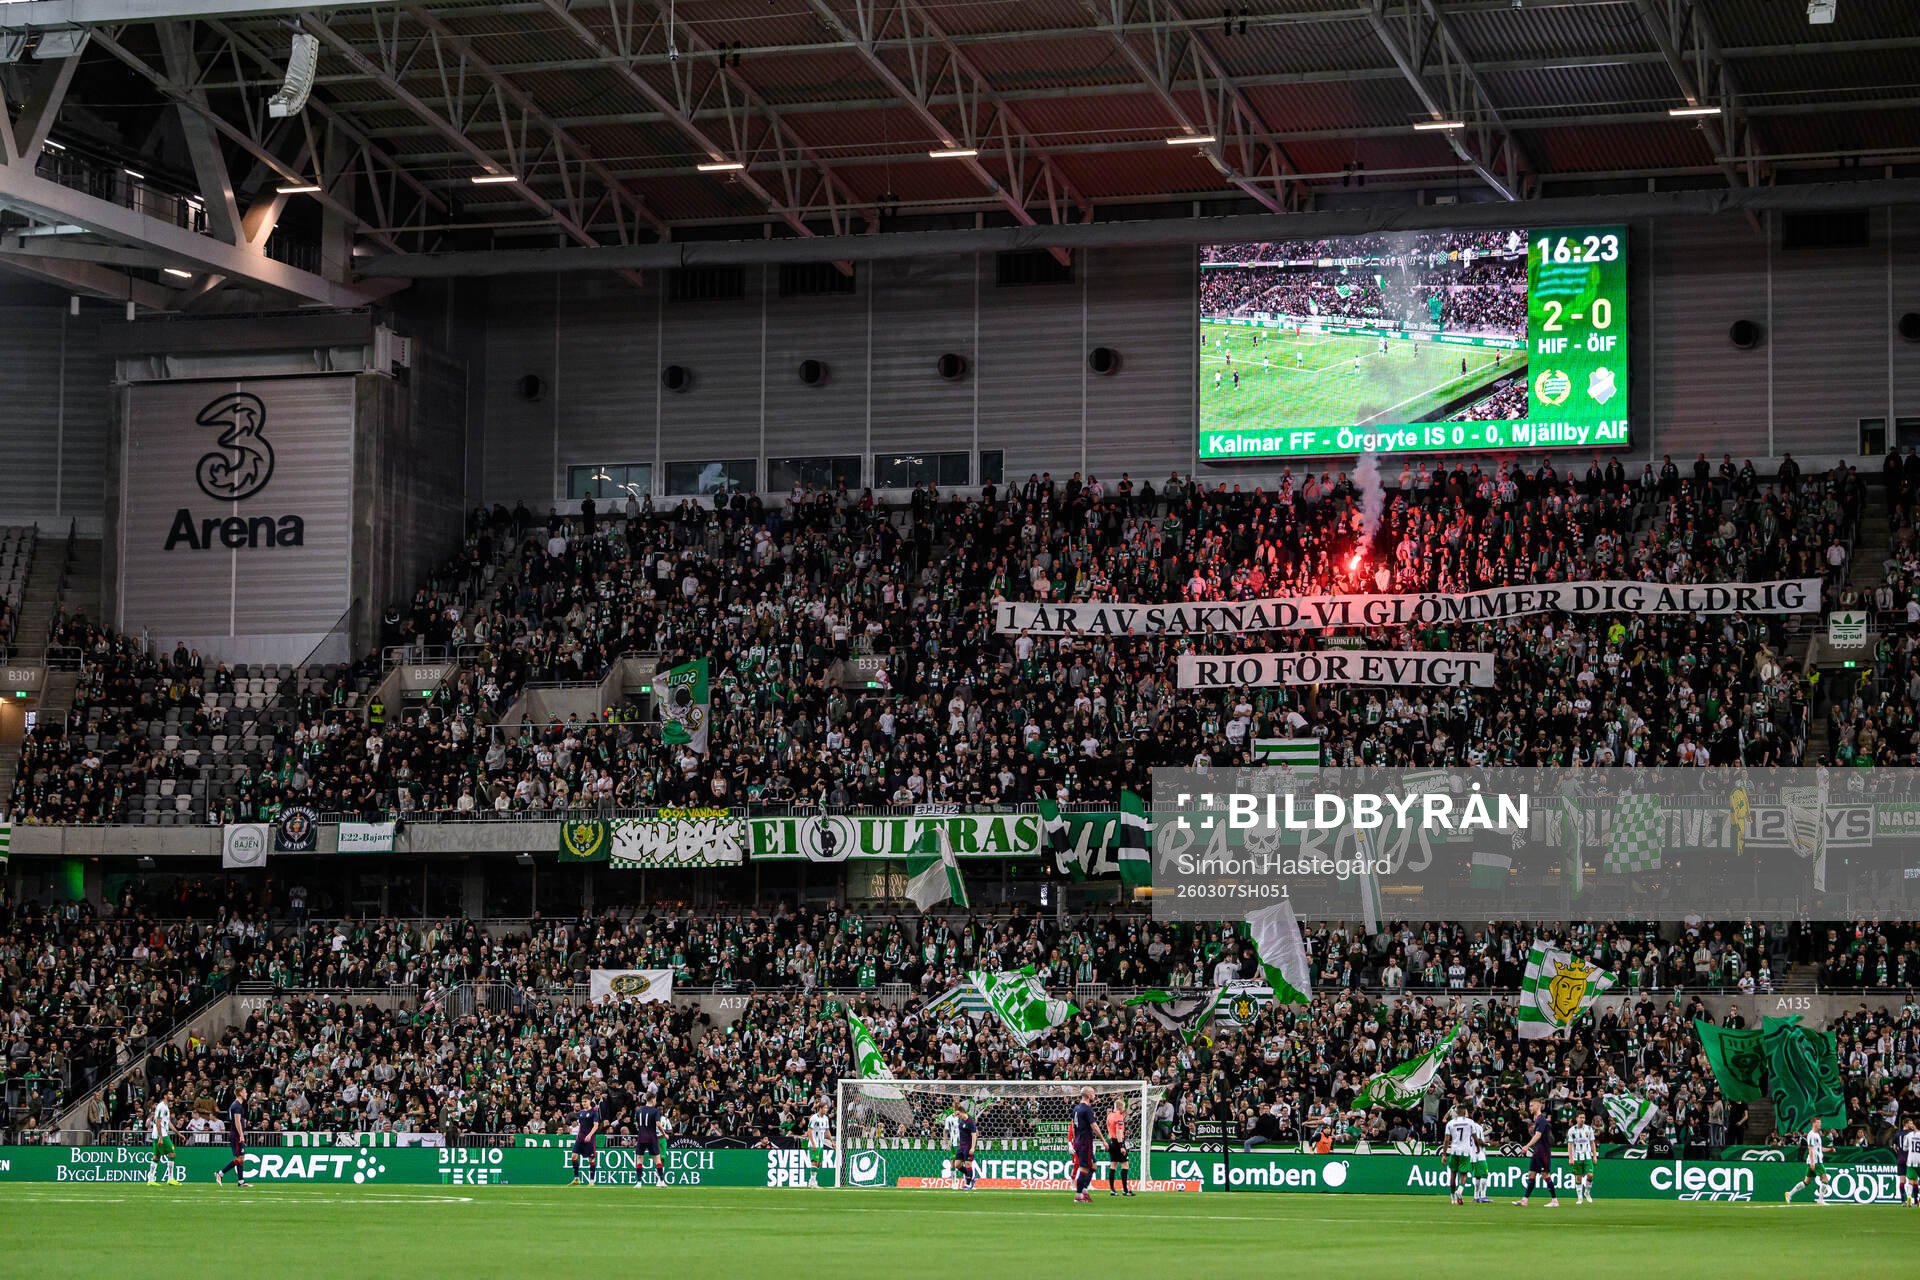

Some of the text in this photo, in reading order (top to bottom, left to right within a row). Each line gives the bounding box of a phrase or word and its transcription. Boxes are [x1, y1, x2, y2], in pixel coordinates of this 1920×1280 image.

[1536, 234, 1619, 265] 16:23
[1543, 300, 1563, 332] 2
[1592, 299, 1612, 329] 0
[1538, 337, 1568, 354] HIF
[1587, 333, 1616, 353] ÖIF
[1209, 432, 1283, 455] Kalmar
[1289, 431, 1315, 451] FF
[1337, 427, 1418, 453] Örgryte
[1423, 426, 1446, 446] IS
[1452, 426, 1464, 444] 0
[1485, 425, 1503, 446] 0,
[1512, 421, 1589, 445] Mjällby
[164, 509, 304, 550] Arena
[1031, 603, 1079, 634] ÅR
[1090, 607, 1138, 634] AV
[1363, 589, 1561, 625] GLÖMMER
[1572, 584, 1646, 612] DIG
[1653, 582, 1807, 612] ALDRIG
[8, 671, 35, 681] B301
[414, 669, 441, 681] B338
[1195, 653, 1481, 686] RIO FÖR EVIGT
[658, 806, 730, 818] 100% VANDALS
[858, 816, 1040, 855] ULTRAS
[234, 840, 259, 849] BAJEN
[719, 998, 750, 1009] A137
[1776, 997, 1811, 1009] A135
[639, 1113, 649, 1127] 11
[1197, 1124, 1236, 1134] Söderrt
[1456, 1128, 1464, 1141] 7
[438, 1148, 503, 1163] BIBLIO
[235, 1153, 352, 1178] CRAFT
[1170, 1160, 1204, 1178] ICA
[1856, 1165, 1898, 1173] TILLSAMM
[438, 1168, 502, 1184] TEKET
[679, 1171, 701, 1185] AB
[767, 1168, 808, 1187] SPEL
[1213, 1161, 1316, 1187] Bomben
[1650, 1159, 1754, 1191] clean
[1126, 1180, 1176, 1192] YNSAM
